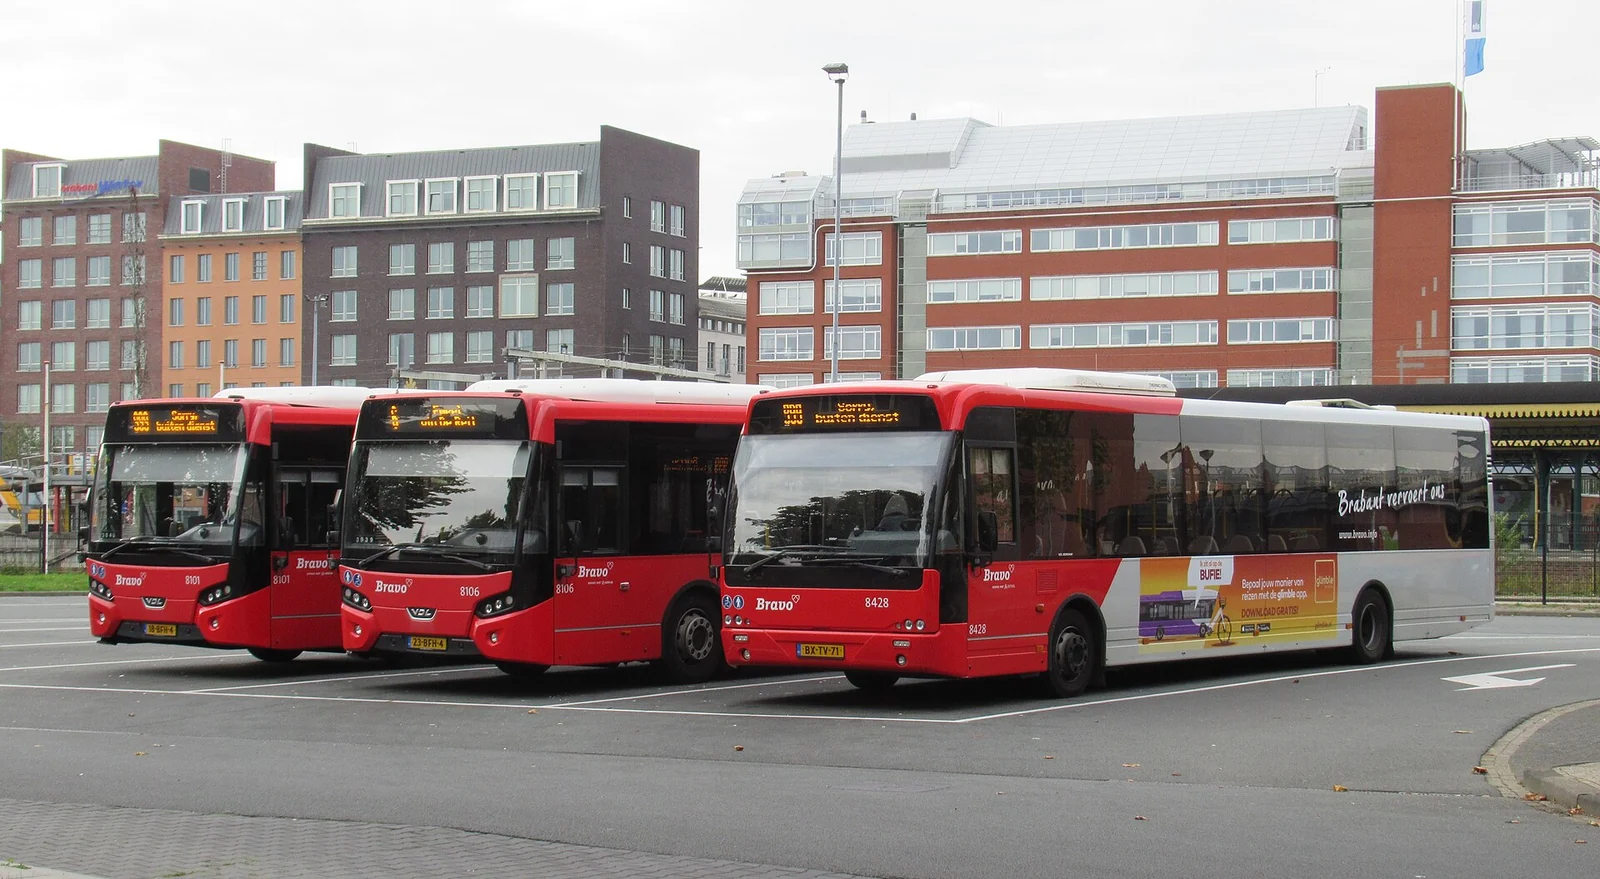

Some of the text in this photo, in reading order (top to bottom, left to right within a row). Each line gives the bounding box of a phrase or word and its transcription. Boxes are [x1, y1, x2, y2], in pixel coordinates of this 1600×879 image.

[815, 412, 899, 423] buiten dienst
[155, 420, 216, 432] buiten dienst
[1338, 480, 1445, 517] Brabant vervoert ons
[1339, 530, 1378, 540] www.bravo.info
[296, 558, 328, 569] Bravo
[578, 564, 608, 578] Bravo
[983, 568, 1010, 582] Bravo
[115, 574, 142, 586] Bravo
[185, 575, 200, 585] 8101
[273, 575, 290, 584] 8101
[1241, 578, 1260, 590] Bepaal
[1260, 578, 1274, 590] jouw
[1275, 577, 1293, 587] manier
[1316, 576, 1334, 587] glimble
[375, 580, 407, 593] Bravo
[460, 586, 480, 597] 8106
[555, 583, 574, 594] 8106
[1241, 589, 1308, 601] reizen met de glimble app.
[756, 598, 793, 611] Bravo
[865, 597, 889, 608] 8428
[1241, 605, 1299, 618] DOWNLOAD GRATIS!
[148, 624, 174, 634] 18-BFH-4
[969, 624, 986, 635] 8428
[413, 638, 444, 648] 23-BFH-4
[805, 645, 839, 656] BX-TV-71
